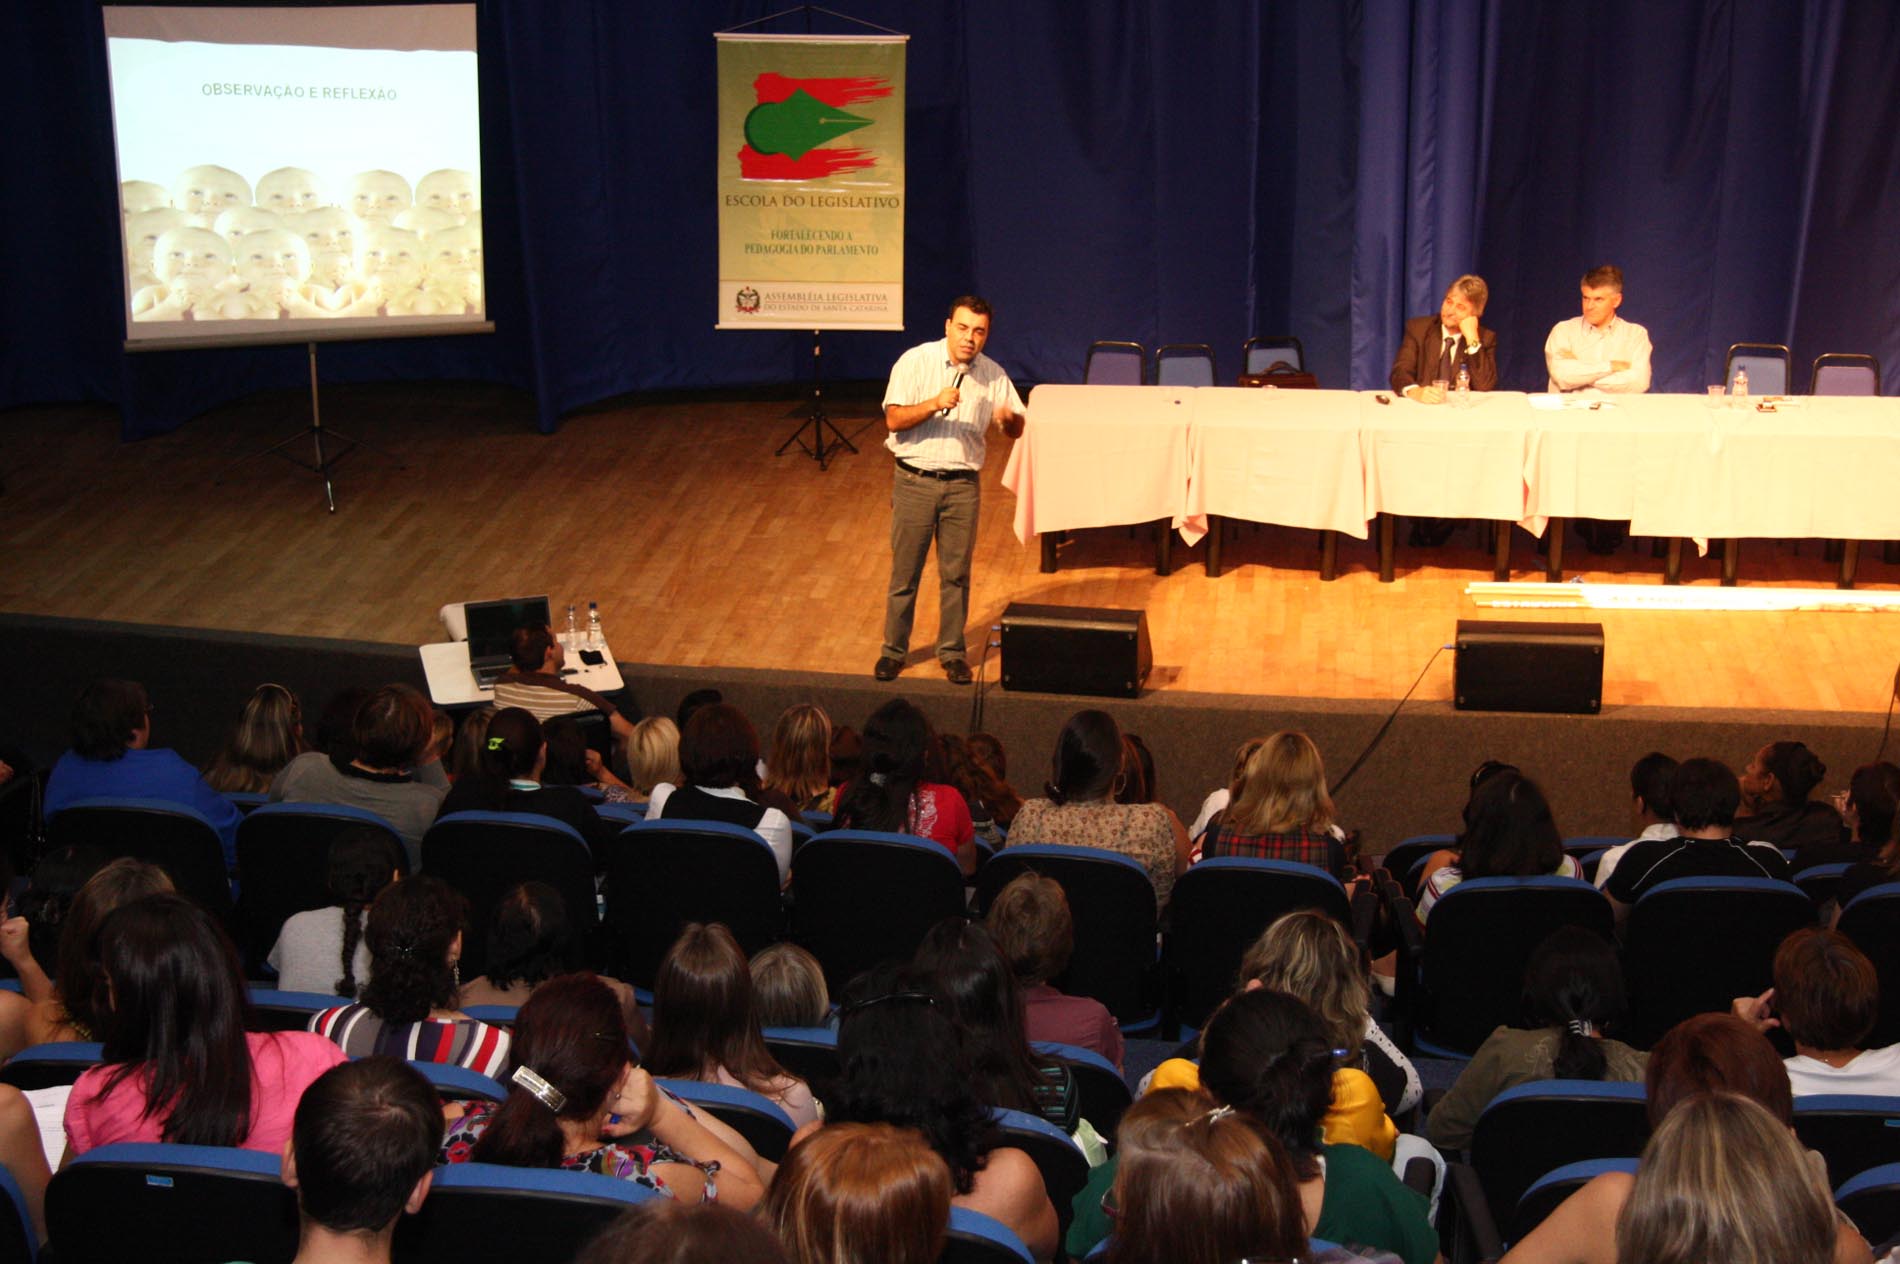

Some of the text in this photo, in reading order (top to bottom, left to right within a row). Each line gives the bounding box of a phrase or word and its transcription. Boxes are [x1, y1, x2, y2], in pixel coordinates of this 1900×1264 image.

[309, 87, 318, 98] E
[725, 194, 900, 209] ESCOLA DO LEGISLATIVO
[770, 229, 853, 241] FORTALECENDO A
[744, 243, 879, 256] PEDAGOGIA DO PARLAMENTO
[826, 292, 888, 301] LEGISLATIVA
[764, 303, 777, 311] DO
